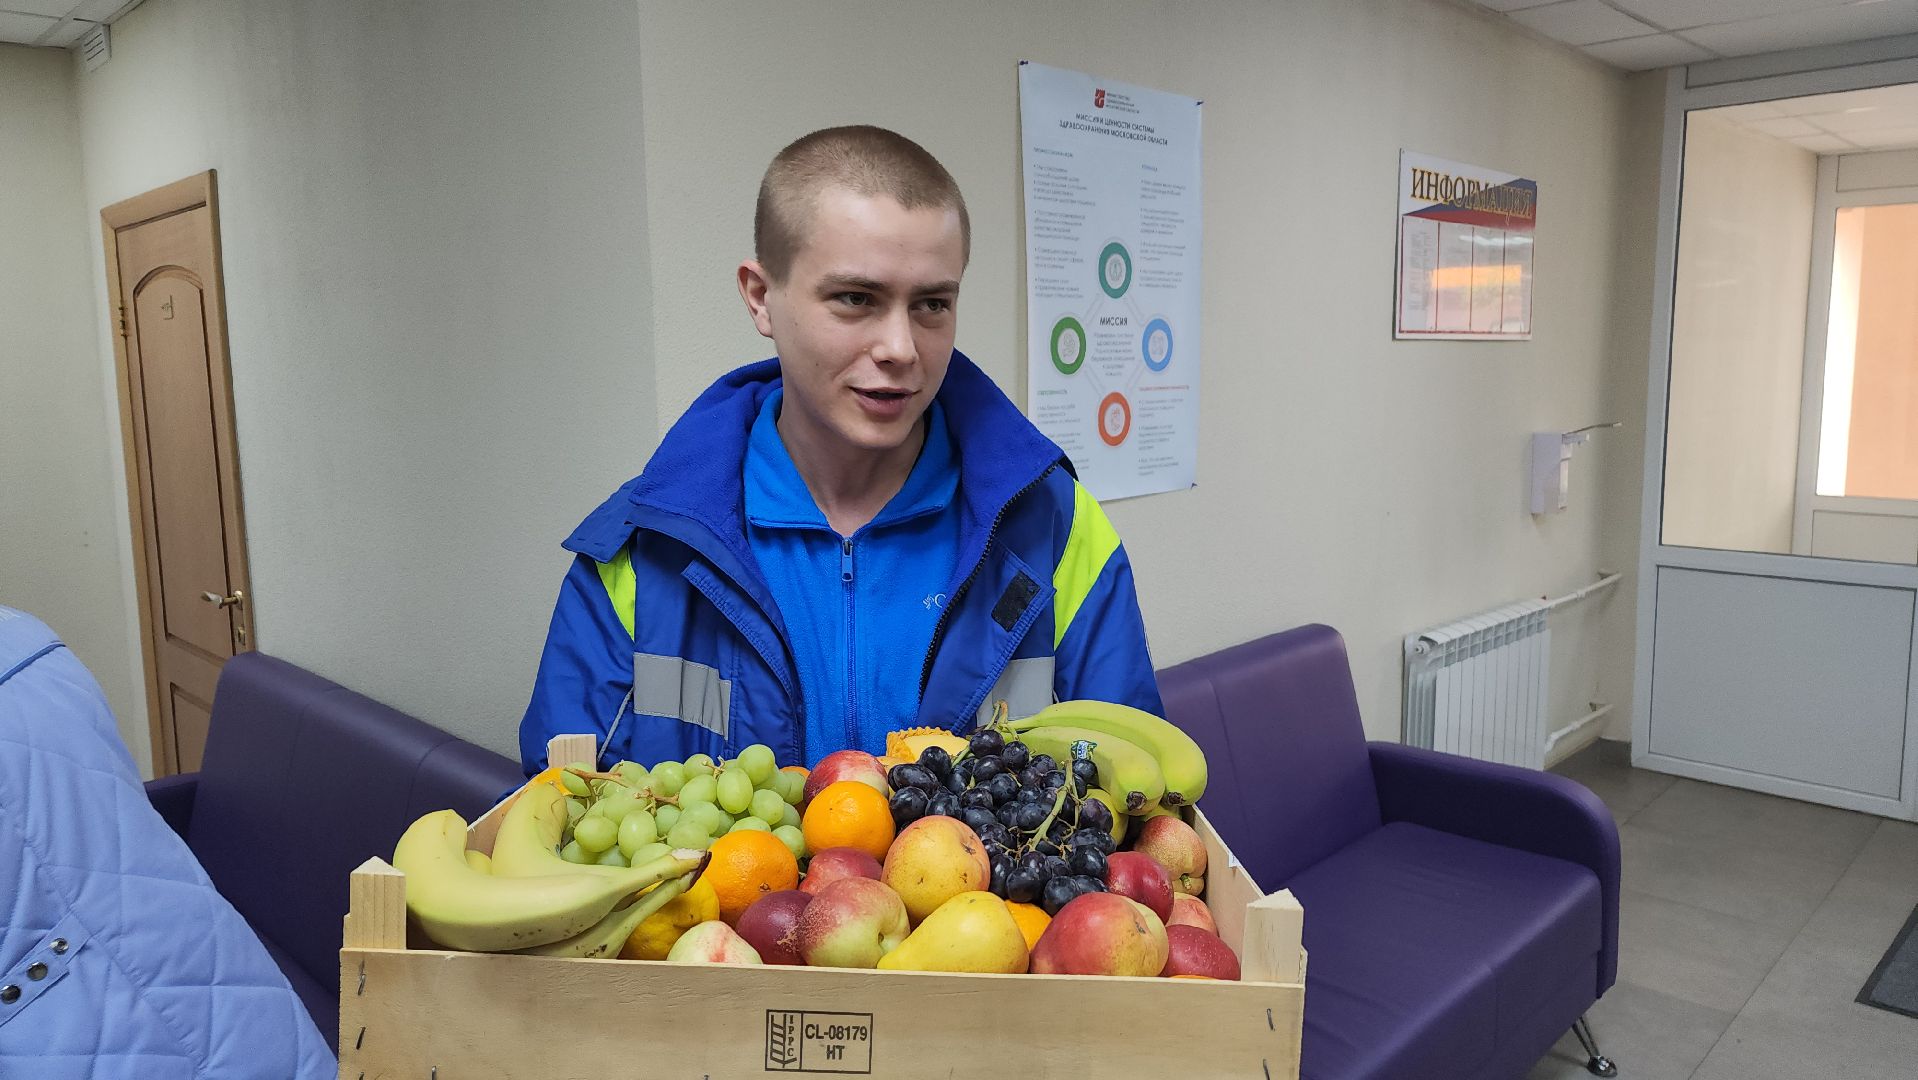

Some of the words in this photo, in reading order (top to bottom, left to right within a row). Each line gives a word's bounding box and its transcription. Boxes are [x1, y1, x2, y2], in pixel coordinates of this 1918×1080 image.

[1410, 167, 1533, 226] ИНФОРМАЦИЯ
[1099, 316, 1128, 327] МИССИЯ
[804, 1023, 868, 1042] CL-08179
[826, 1044, 846, 1060] HT
